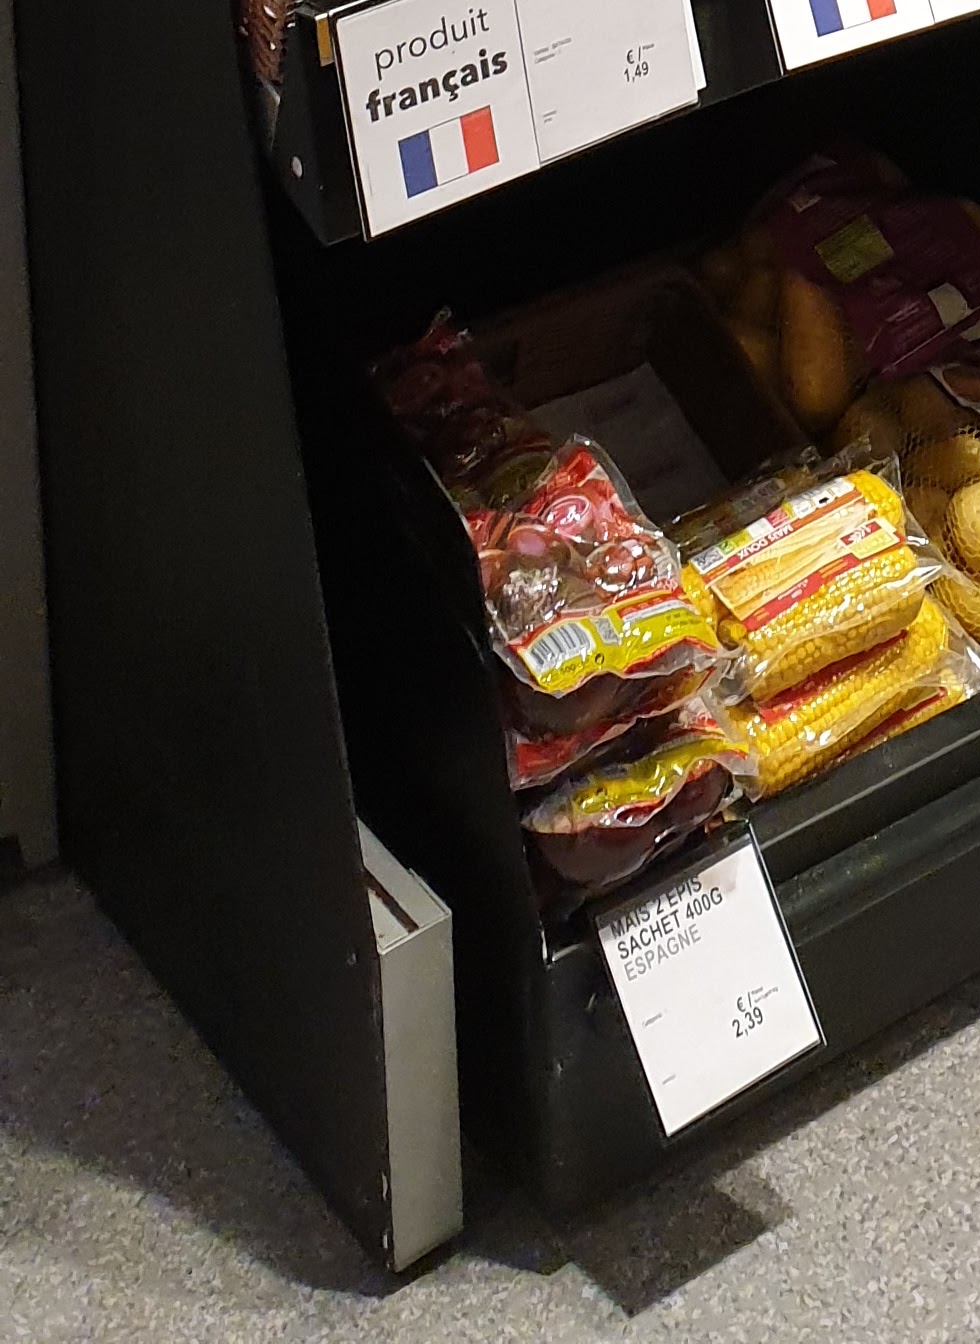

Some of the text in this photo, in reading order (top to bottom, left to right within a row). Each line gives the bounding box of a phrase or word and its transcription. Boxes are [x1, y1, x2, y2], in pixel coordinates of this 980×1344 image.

[374, 8, 490, 81] produit
[623, 61, 649, 83] 1,49
[365, 48, 509, 123] français
[610, 904, 652, 939] MAIS
[667, 876, 703, 909] EPIS
[618, 886, 724, 960] SACHET 400G
[623, 923, 702, 982] ESPAGNE
[732, 1006, 765, 1039] 2,39
